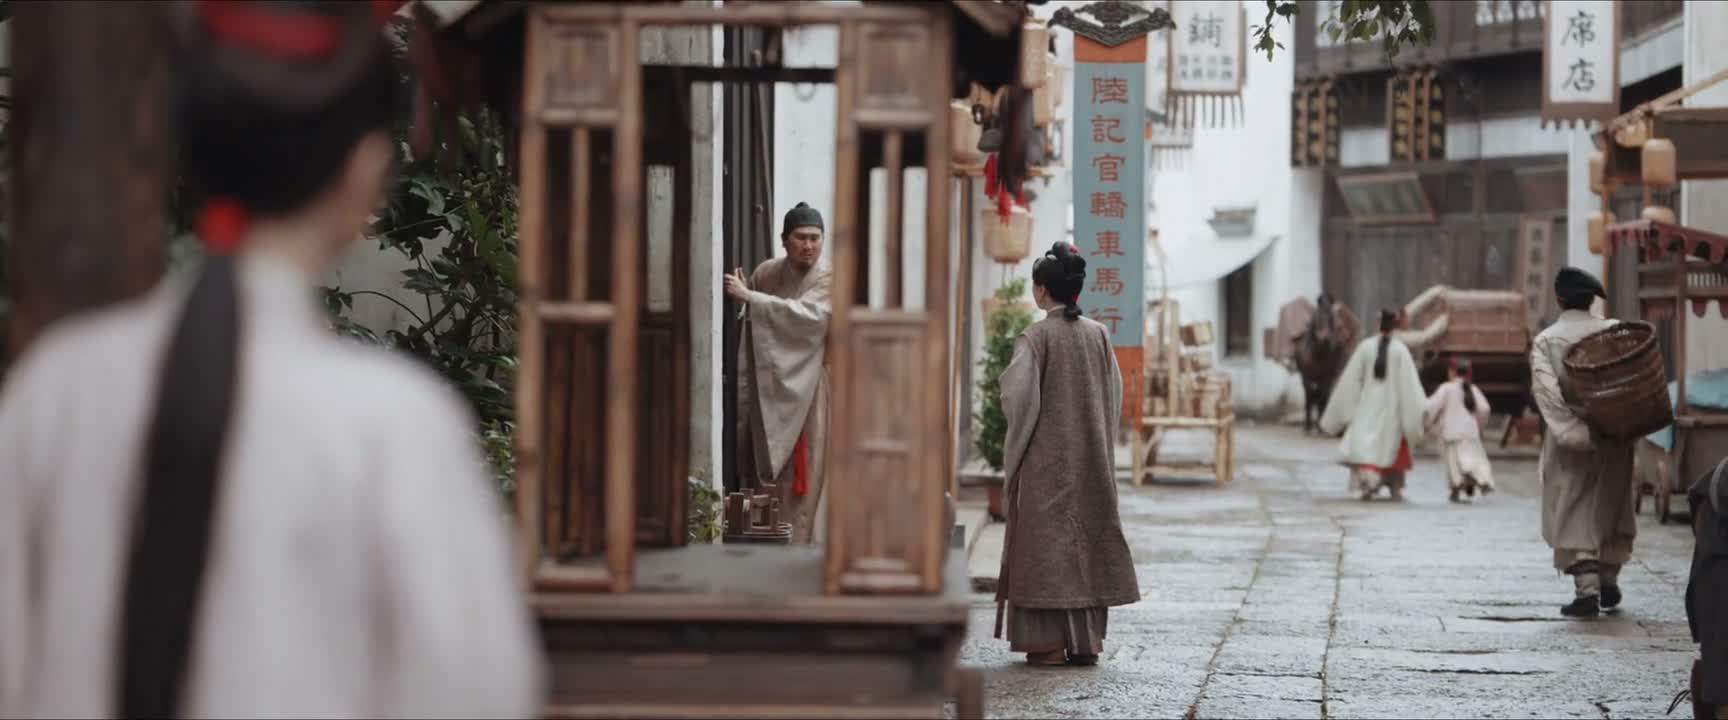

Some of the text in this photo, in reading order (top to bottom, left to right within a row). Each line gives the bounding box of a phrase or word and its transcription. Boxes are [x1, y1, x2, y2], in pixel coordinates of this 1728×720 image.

[1560, 10, 1597, 92] 席店
[1090, 76, 1129, 336] 陸記官轎車馬行
